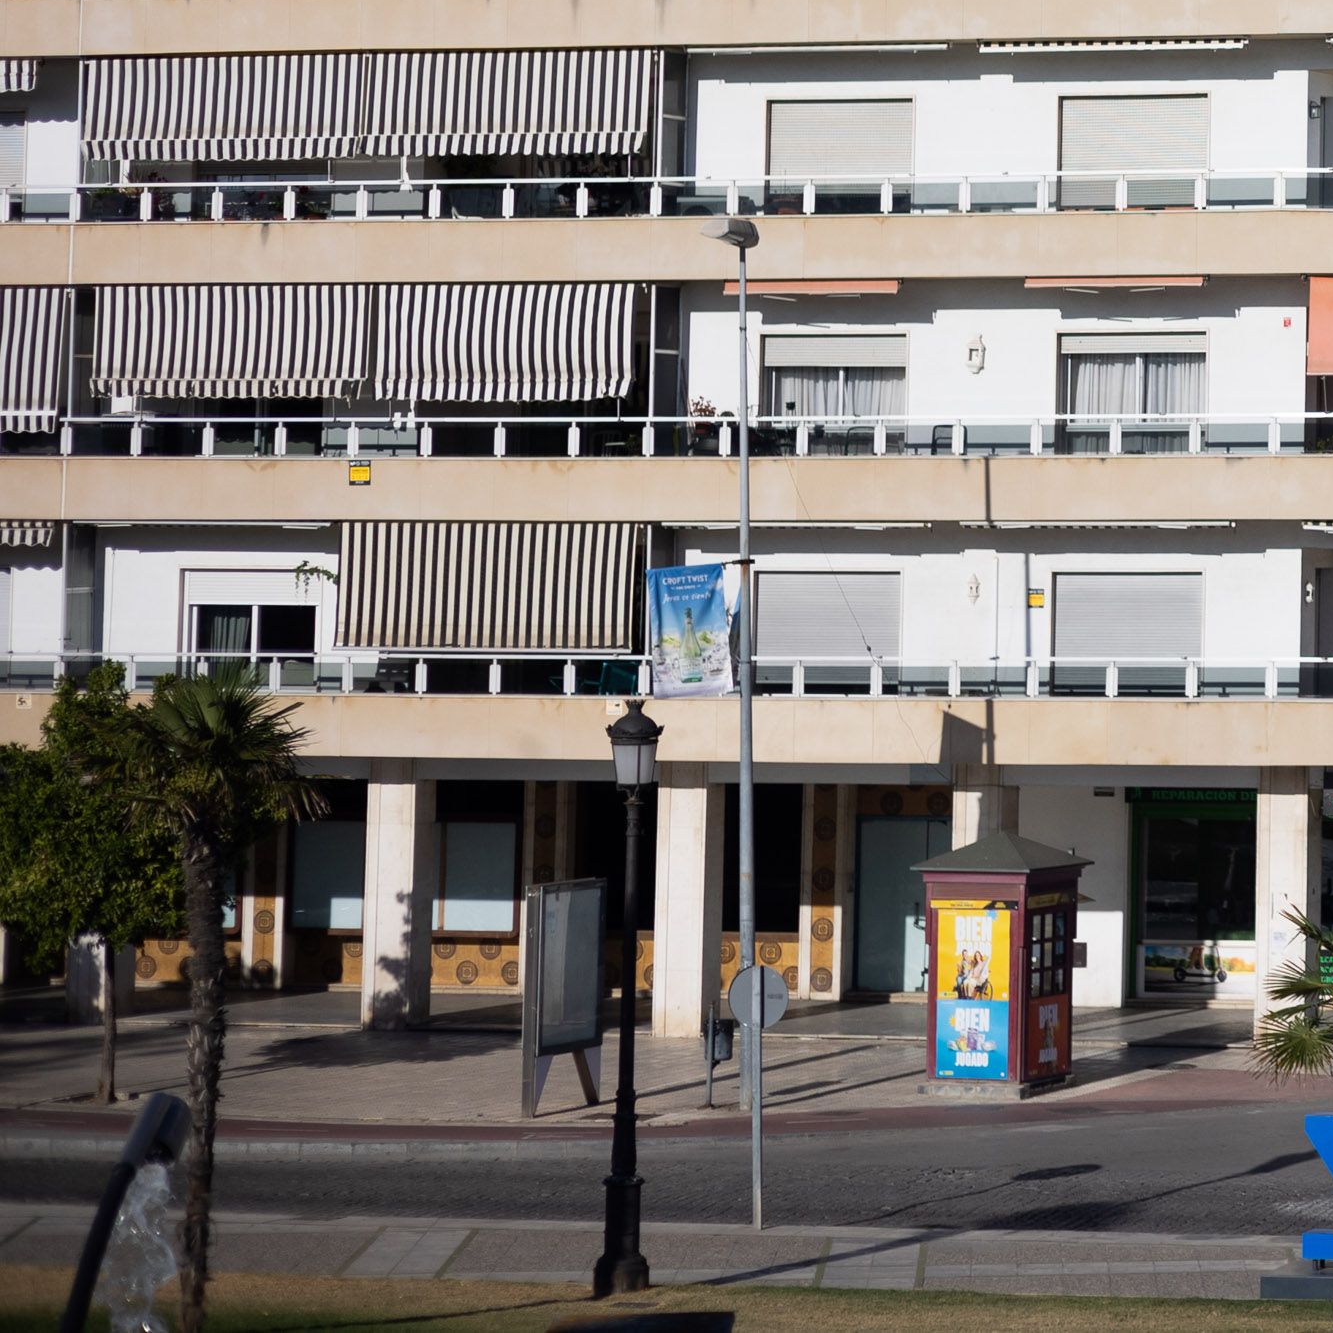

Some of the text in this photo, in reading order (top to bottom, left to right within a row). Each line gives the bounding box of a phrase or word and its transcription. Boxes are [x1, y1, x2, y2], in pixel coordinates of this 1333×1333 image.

[662, 574, 708, 586] CROFT TWIST
[1152, 788, 1236, 801] REPARACIÓN
[955, 916, 992, 941] BIEN
[954, 1007, 990, 1032] BIEN
[954, 1051, 989, 1067] JUGADO
